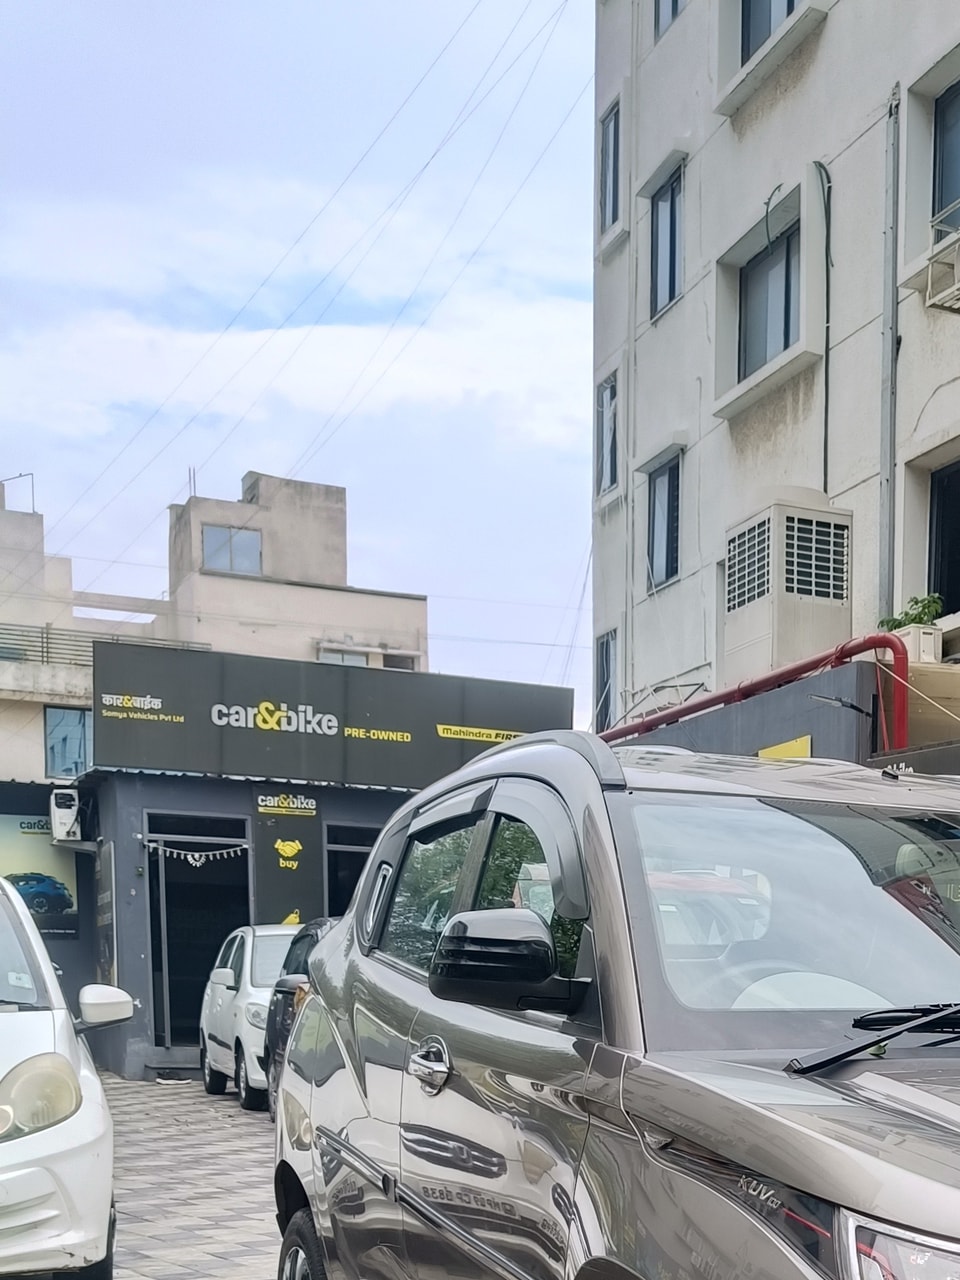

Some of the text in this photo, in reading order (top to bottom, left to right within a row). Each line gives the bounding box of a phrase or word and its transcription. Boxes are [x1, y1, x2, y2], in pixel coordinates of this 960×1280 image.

[101, 709, 185, 723] Somya Vehicles Pvt Ltd
[211, 701, 411, 742] car&bike PRE-OWNED
[442, 727, 524, 741] Mahindra FIR
[257, 793, 317, 809] car&bike
[19, 819, 52, 831] car&b
[279, 857, 299, 870] buy
